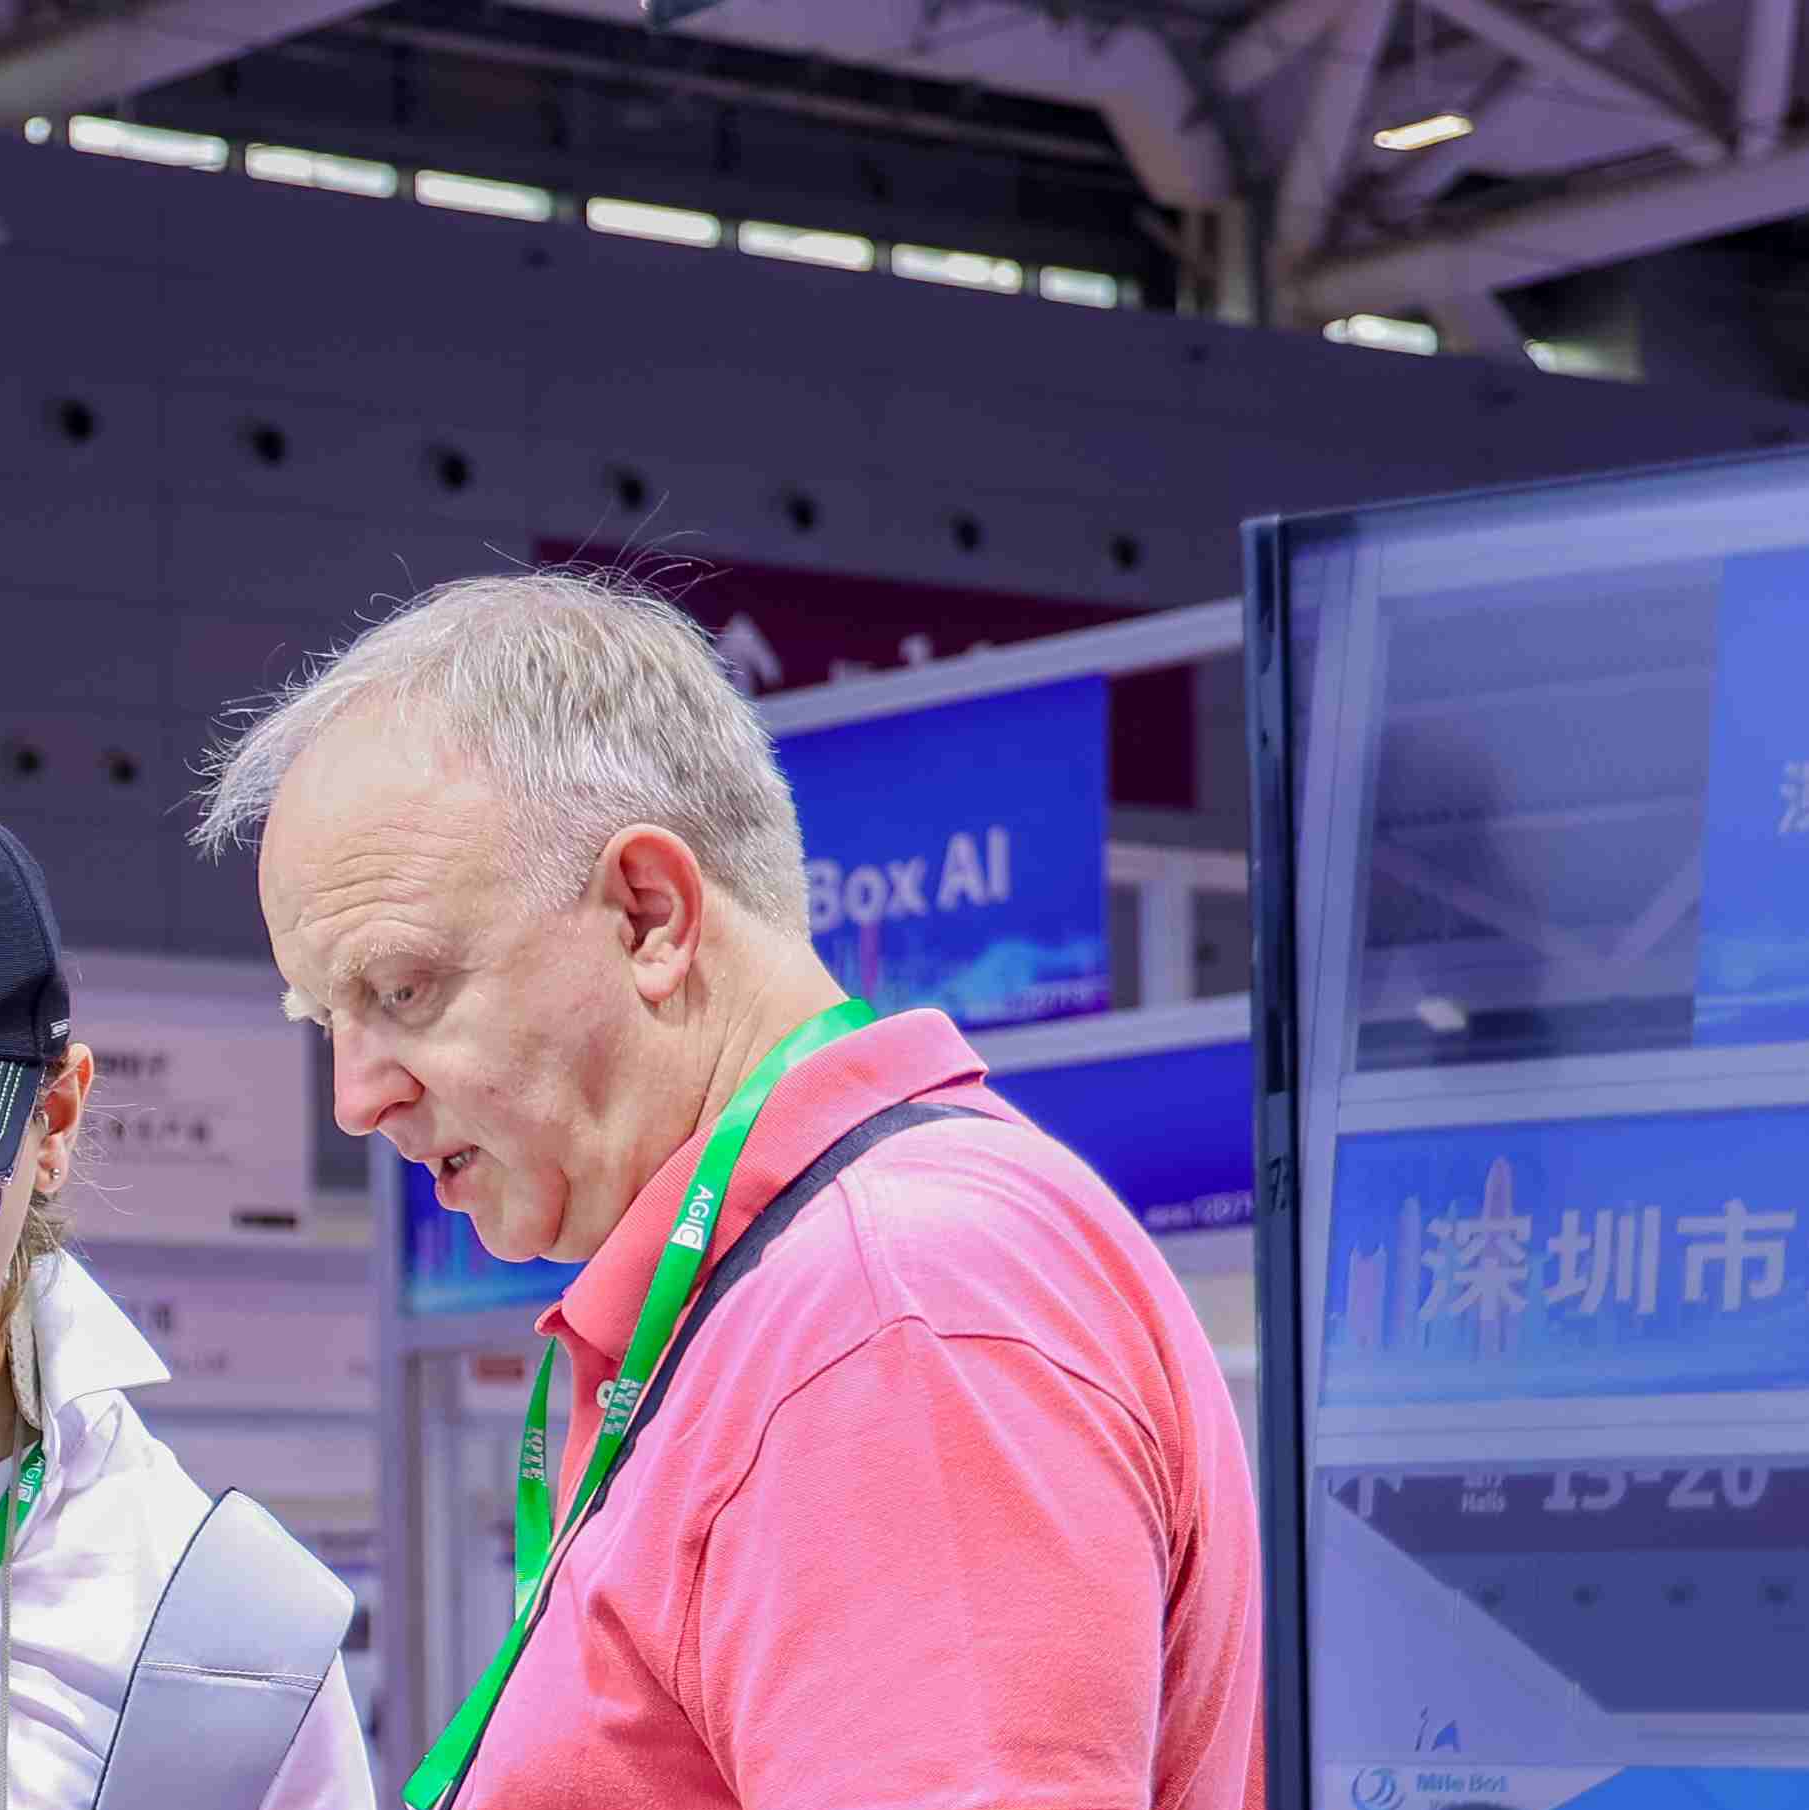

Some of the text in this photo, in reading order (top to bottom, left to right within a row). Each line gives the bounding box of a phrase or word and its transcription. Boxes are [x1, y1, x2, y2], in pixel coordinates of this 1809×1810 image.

[936, 825, 1012, 913] AI
[669, 1184, 714, 1251] AGIC
[1420, 1198, 1798, 1320] 深圳市
